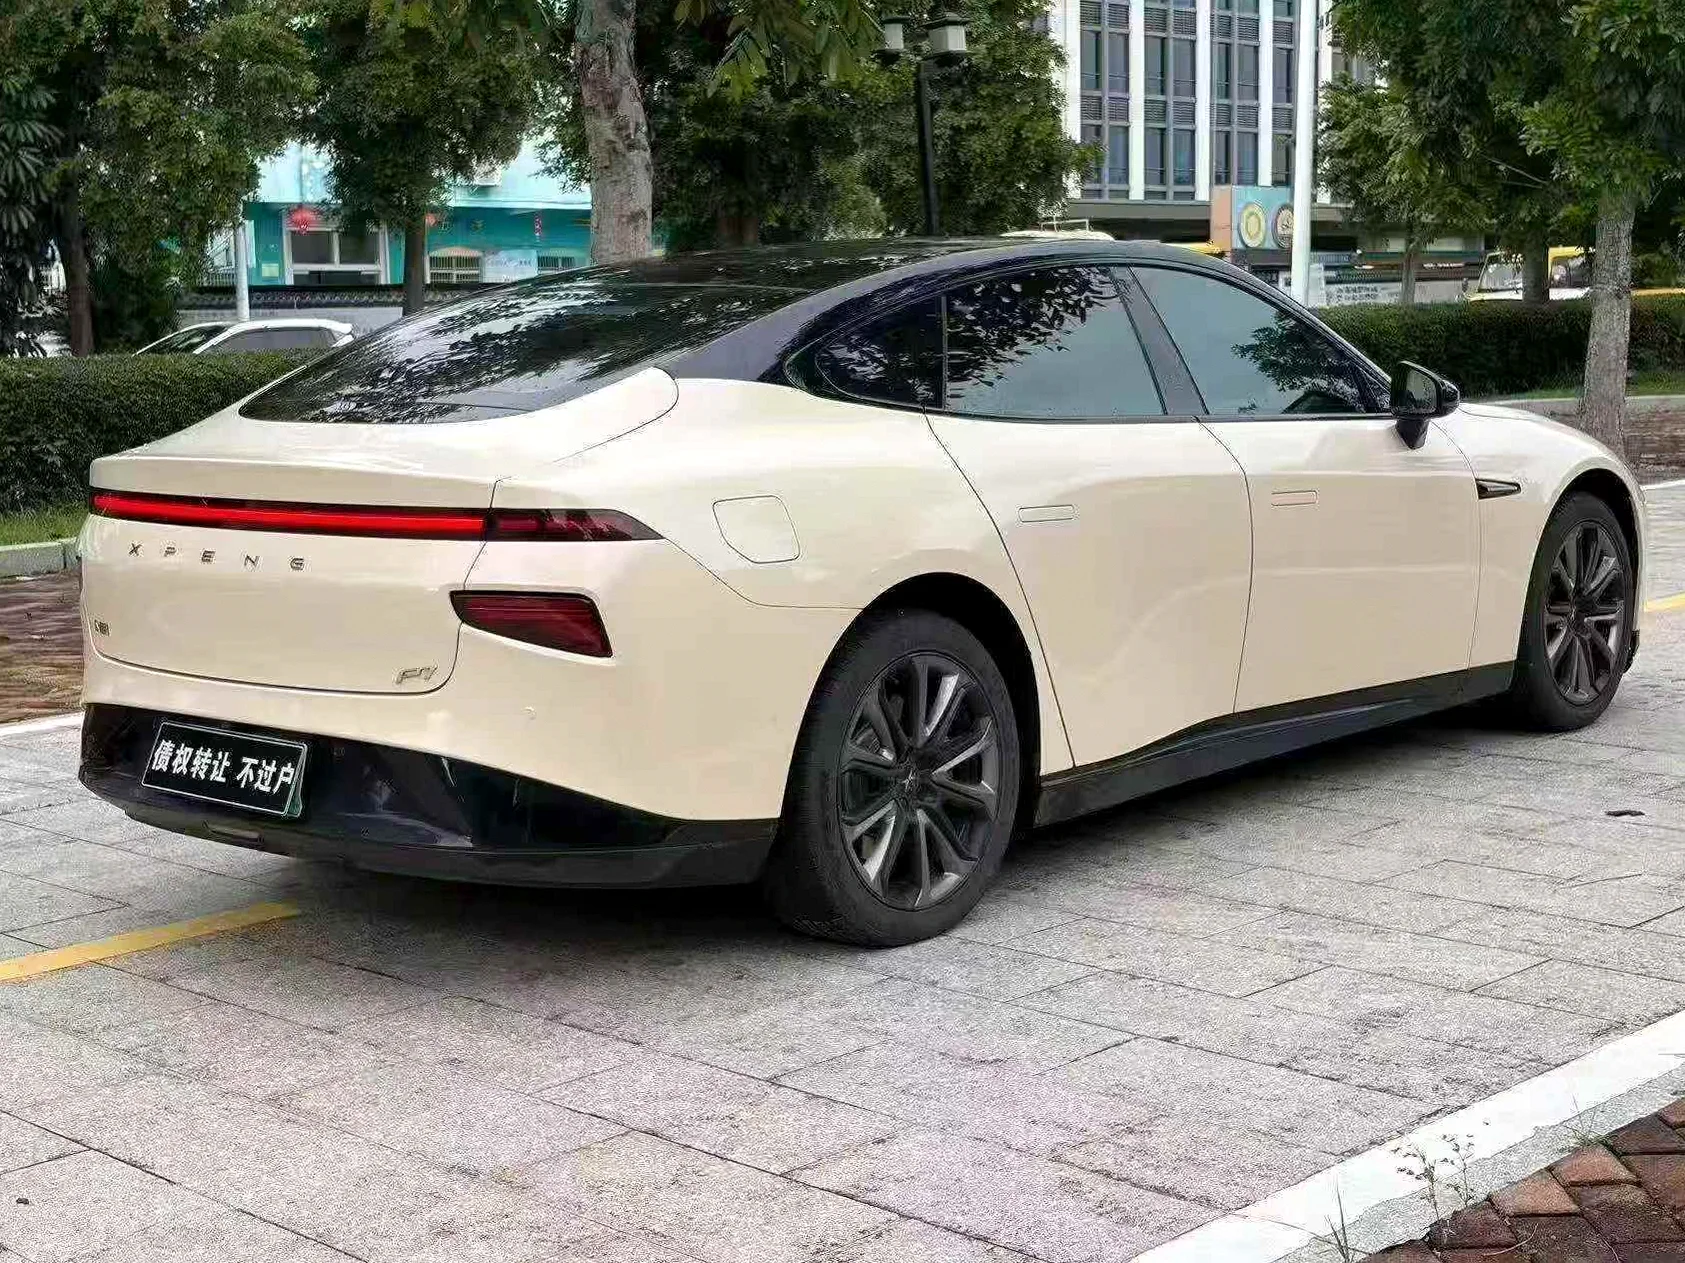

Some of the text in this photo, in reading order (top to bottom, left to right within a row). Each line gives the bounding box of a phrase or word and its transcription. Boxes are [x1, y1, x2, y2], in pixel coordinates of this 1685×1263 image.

[128, 542, 306, 571] XPENG
[151, 739, 295, 795] 债权转让 不过户
